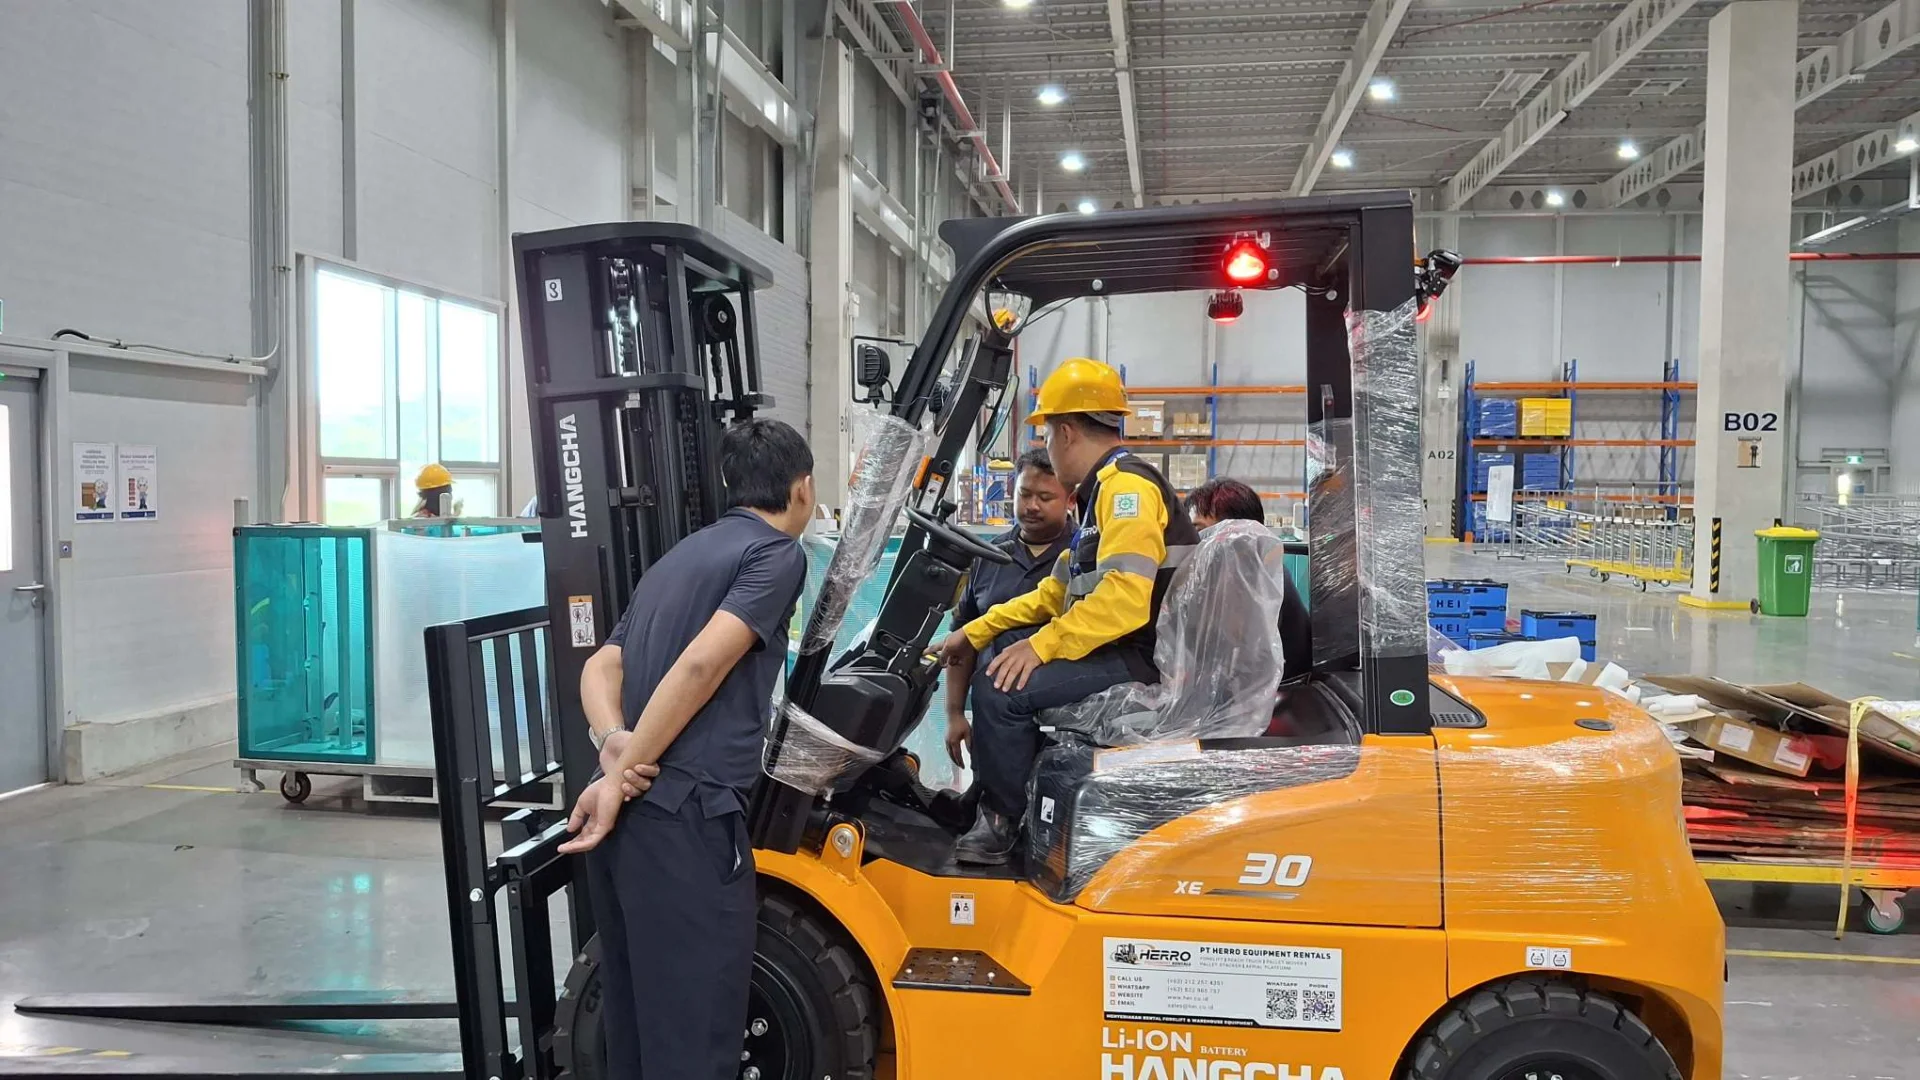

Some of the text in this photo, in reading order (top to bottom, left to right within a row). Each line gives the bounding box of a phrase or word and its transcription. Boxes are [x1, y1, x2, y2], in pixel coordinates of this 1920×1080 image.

[1724, 412, 1778, 431] B02
[1427, 450, 1455, 460] A02
[559, 413, 588, 538] HANGCHA
[1436, 600, 1461, 608] HEI
[1238, 852, 1313, 887] 30
[1174, 880, 1203, 895] XE
[1139, 949, 1192, 962] HERRO
[1212, 947, 1241, 956] HERRO
[1243, 949, 1291, 958] EQUIPMENT
[1294, 951, 1331, 960] RENTALS
[1102, 1027, 1192, 1053] Li-ION
[1200, 1046, 1248, 1056] BATTERY
